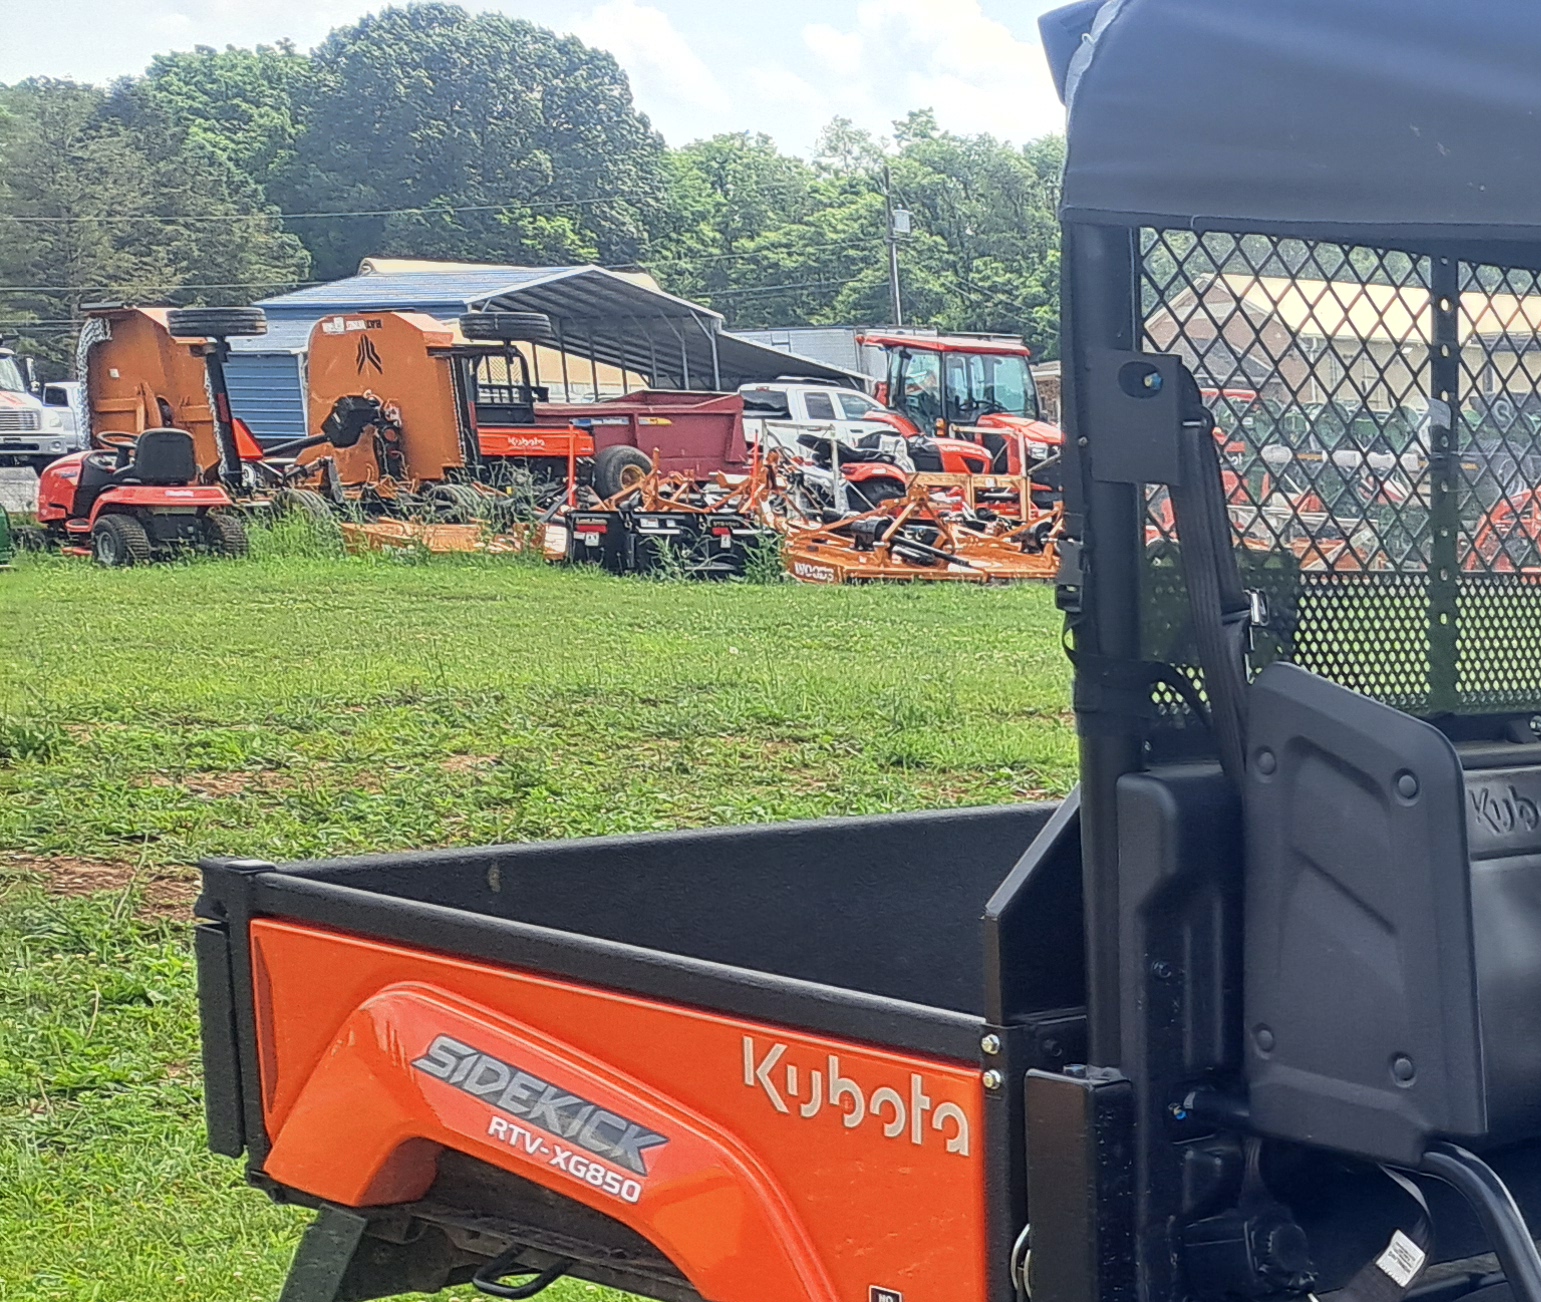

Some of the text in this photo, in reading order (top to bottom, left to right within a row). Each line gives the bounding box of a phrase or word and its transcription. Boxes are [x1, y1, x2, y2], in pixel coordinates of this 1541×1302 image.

[410, 1032, 670, 1177] SIDEKICK
[742, 1035, 970, 1157] Kubota
[486, 1115, 644, 1206] RTV-XG850
